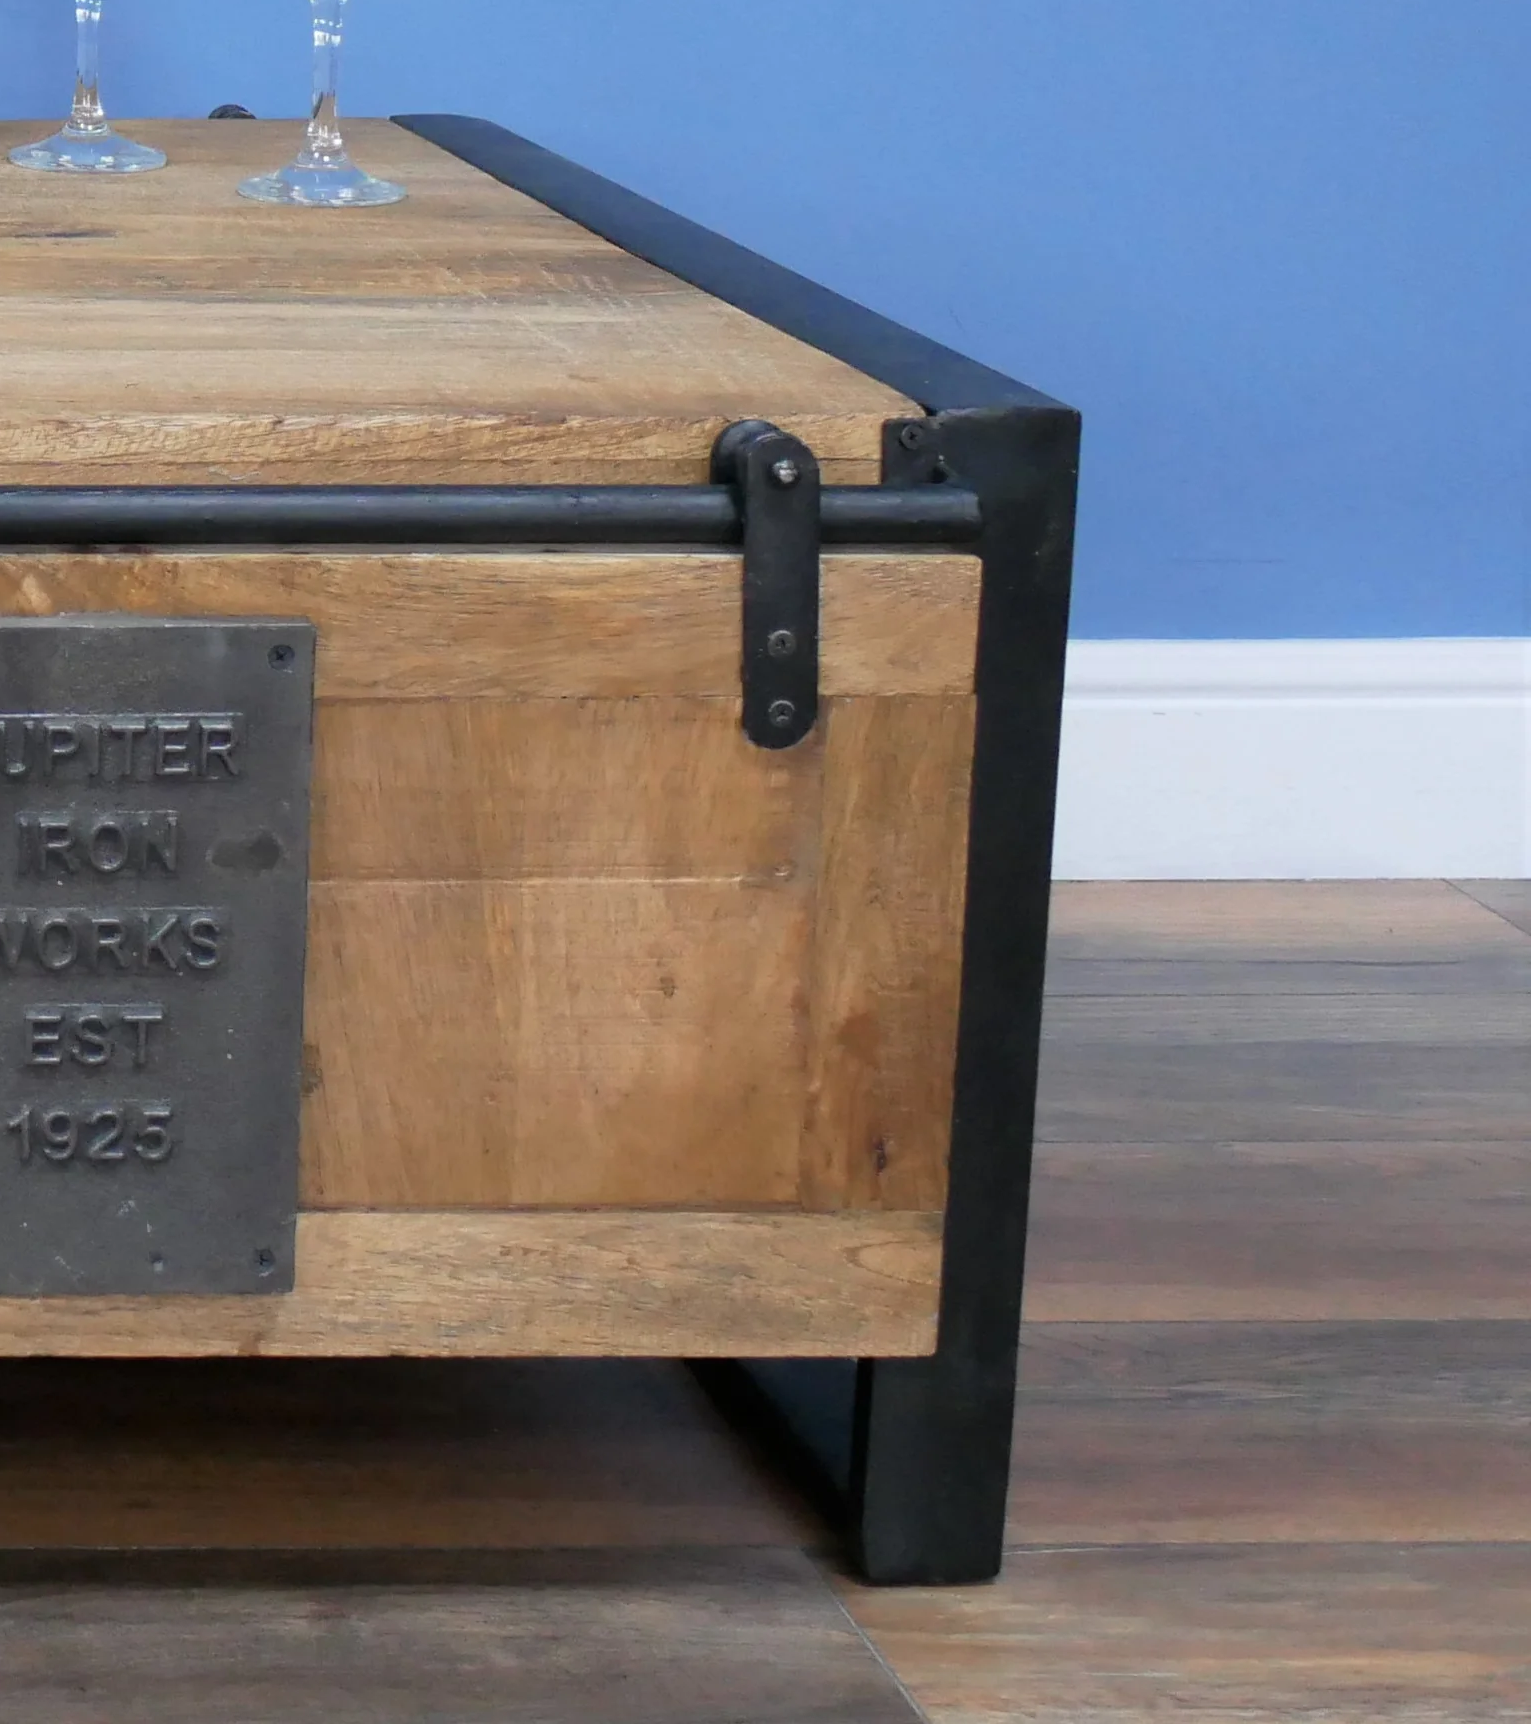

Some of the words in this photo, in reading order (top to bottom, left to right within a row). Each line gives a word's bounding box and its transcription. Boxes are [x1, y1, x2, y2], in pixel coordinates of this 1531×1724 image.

[18, 817, 181, 873] IRON
[26, 1014, 163, 1066] EST
[7, 1105, 172, 1162] 1925
